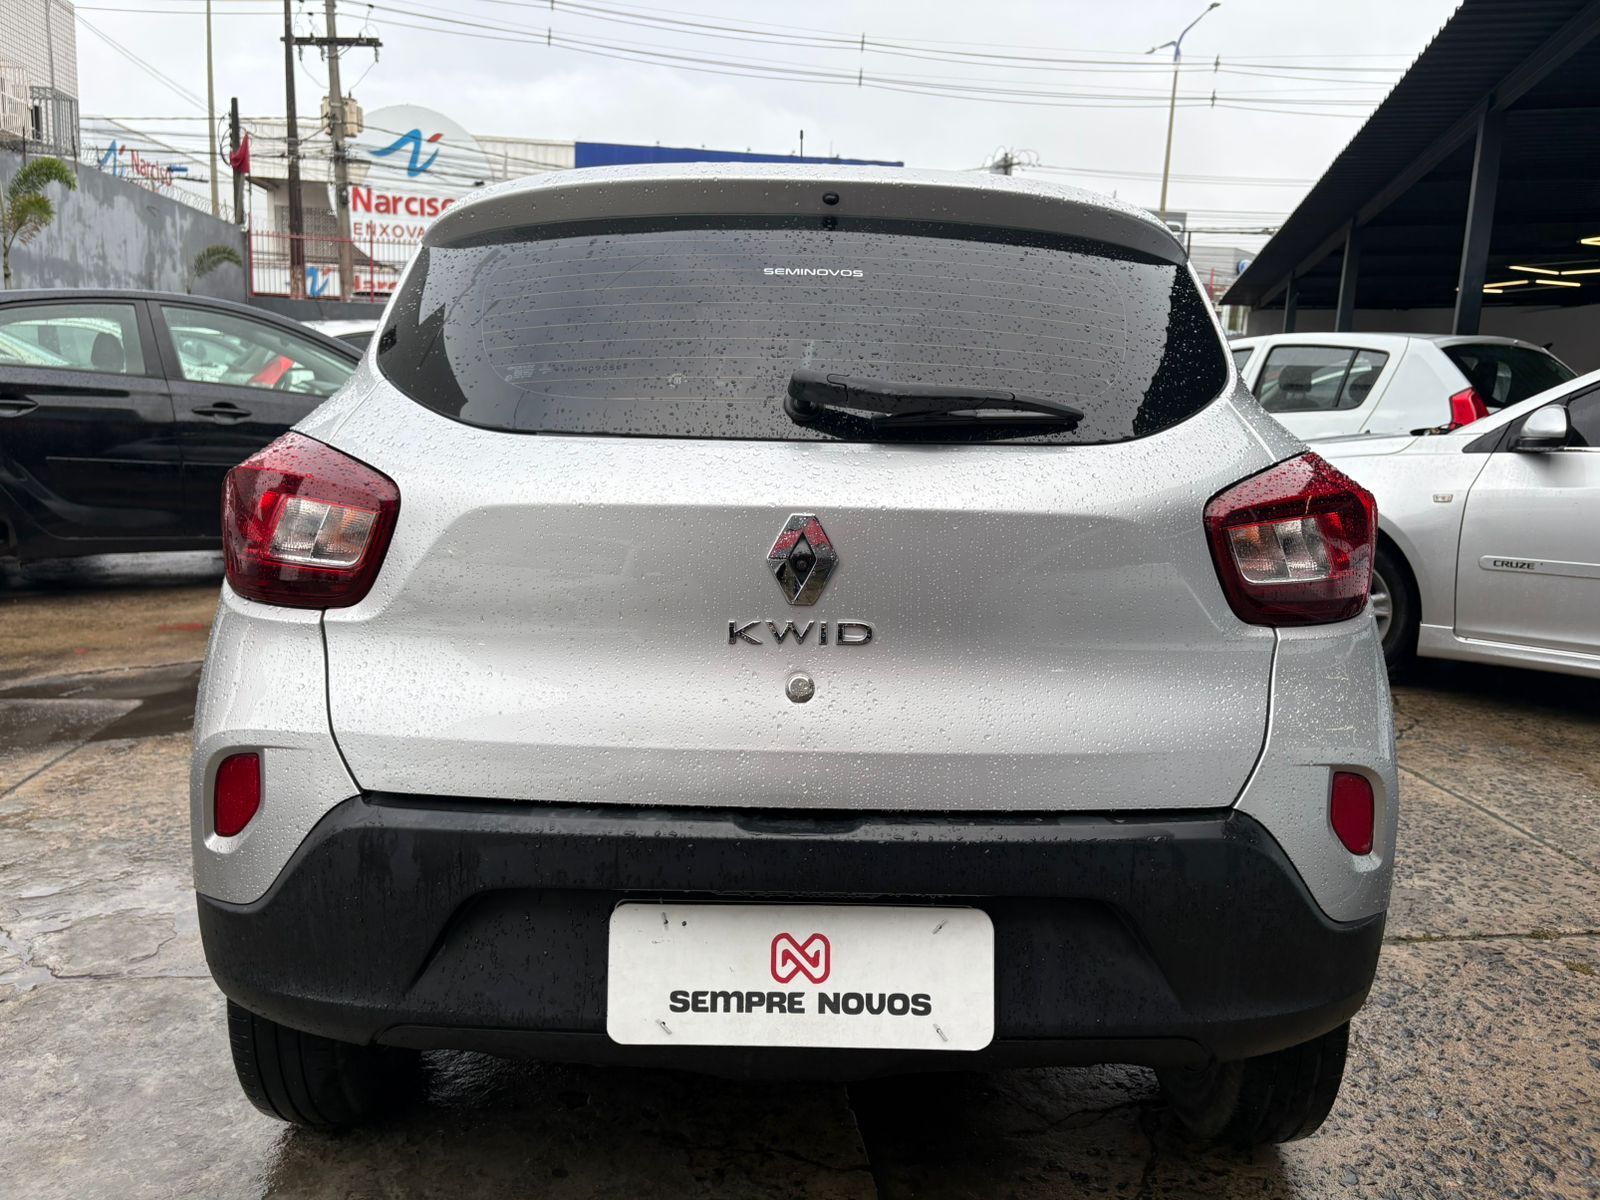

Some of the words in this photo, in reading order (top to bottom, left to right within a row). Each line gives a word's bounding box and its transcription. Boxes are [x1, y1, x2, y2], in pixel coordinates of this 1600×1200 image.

[131, 150, 172, 186] Narciso
[763, 267, 864, 277] SEMINOVOS
[1493, 560, 1536, 570] CRUZE
[728, 619, 873, 645] KWID
[669, 990, 805, 1014] SEMPRE
[818, 992, 932, 1016] NOVOS
